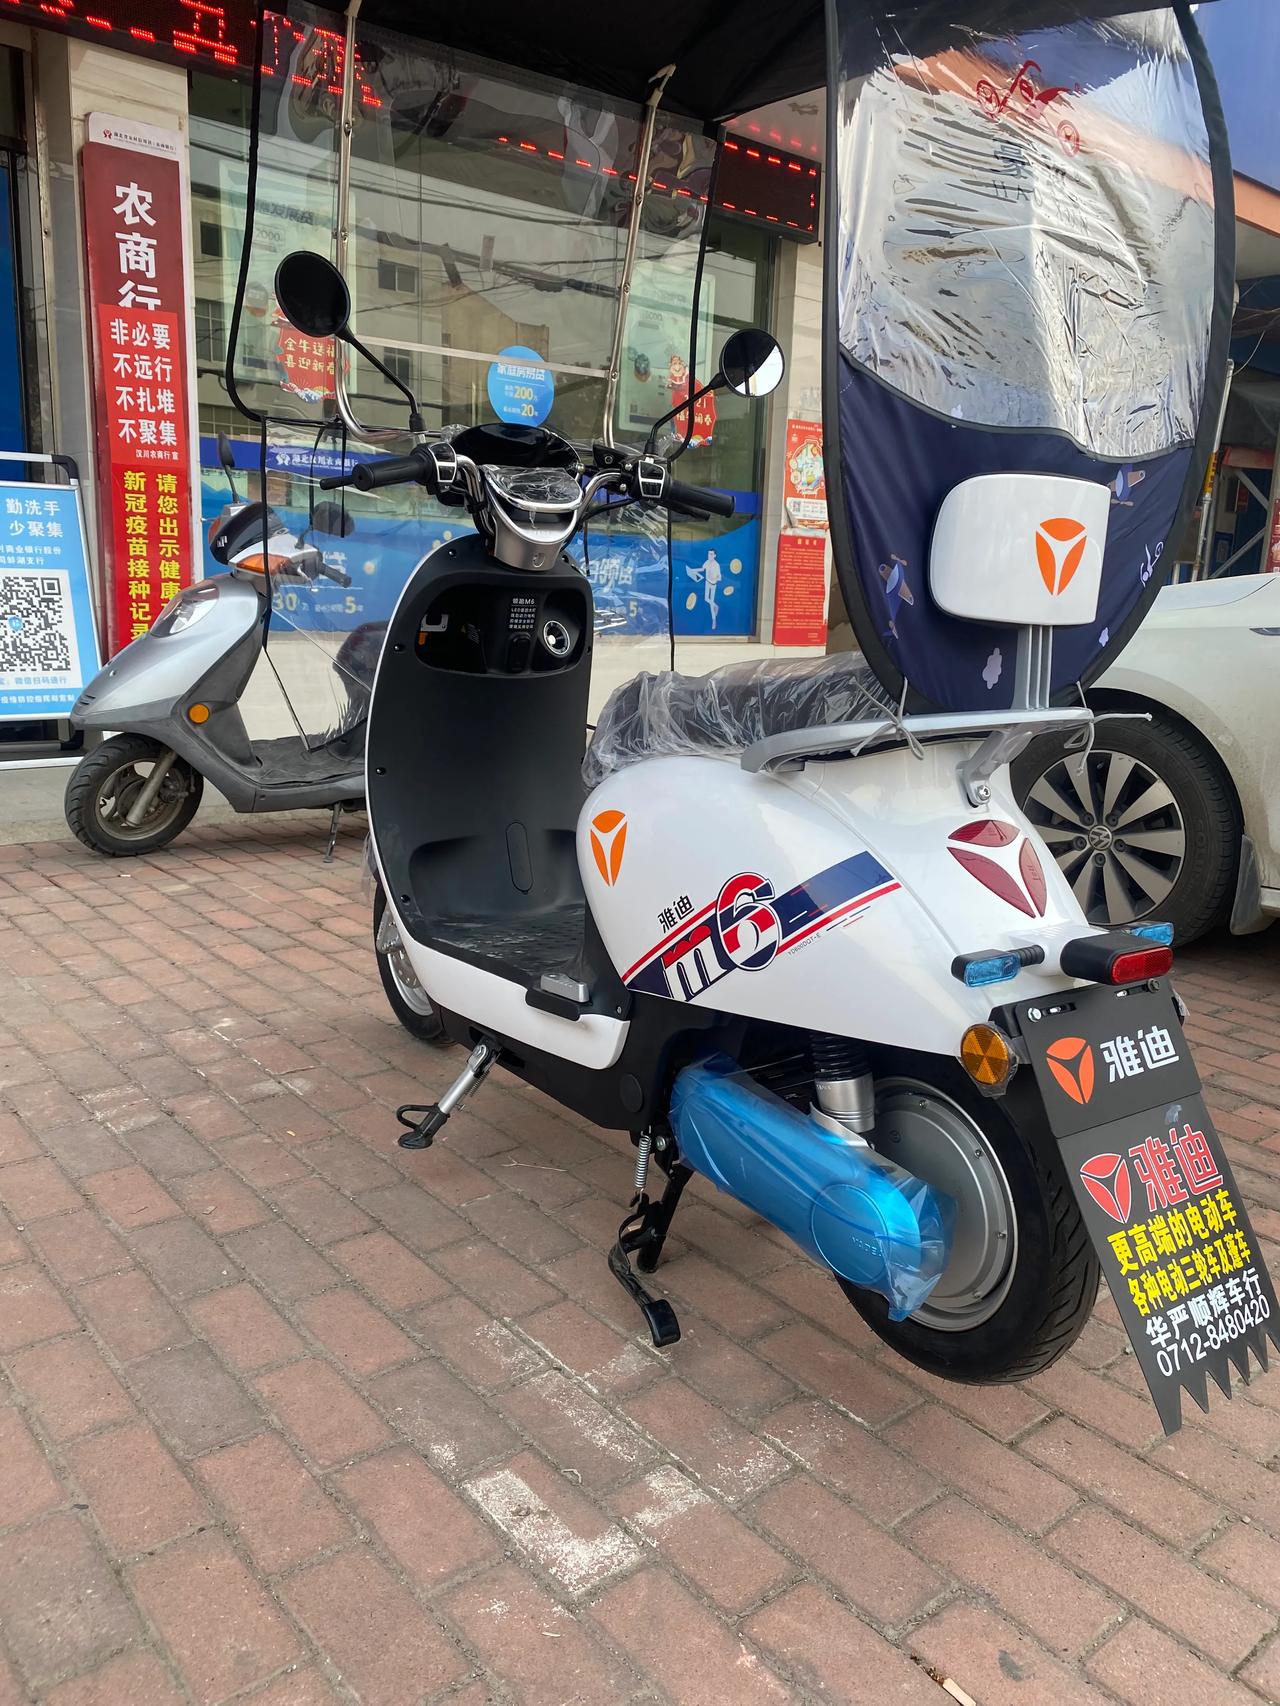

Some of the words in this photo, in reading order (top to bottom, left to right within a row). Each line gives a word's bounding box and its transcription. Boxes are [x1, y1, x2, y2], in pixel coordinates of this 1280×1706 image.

[112, 181, 162, 311] 农商行
[110, 318, 171, 350] 非必要
[112, 353, 173, 383] 不远行
[115, 386, 175, 415] 不扎堆
[118, 419, 177, 447] 不聚集
[5, 497, 61, 517] 勤洗手
[9, 520, 64, 538] 少聚集
[124, 471, 152, 641] 新冠疫苗接种记录
[156, 473, 181, 608] 请您出示健康
[657, 895, 695, 934] 雅迪
[1100, 1025, 1180, 1083] 雅迪
[1128, 1123, 1223, 1212] 雅迪
[1107, 1188, 1238, 1276] 更高端的电动车
[1145, 1267, 1262, 1348] 华严顺辉车行
[1156, 1294, 1270, 1377] 0712-8480420
